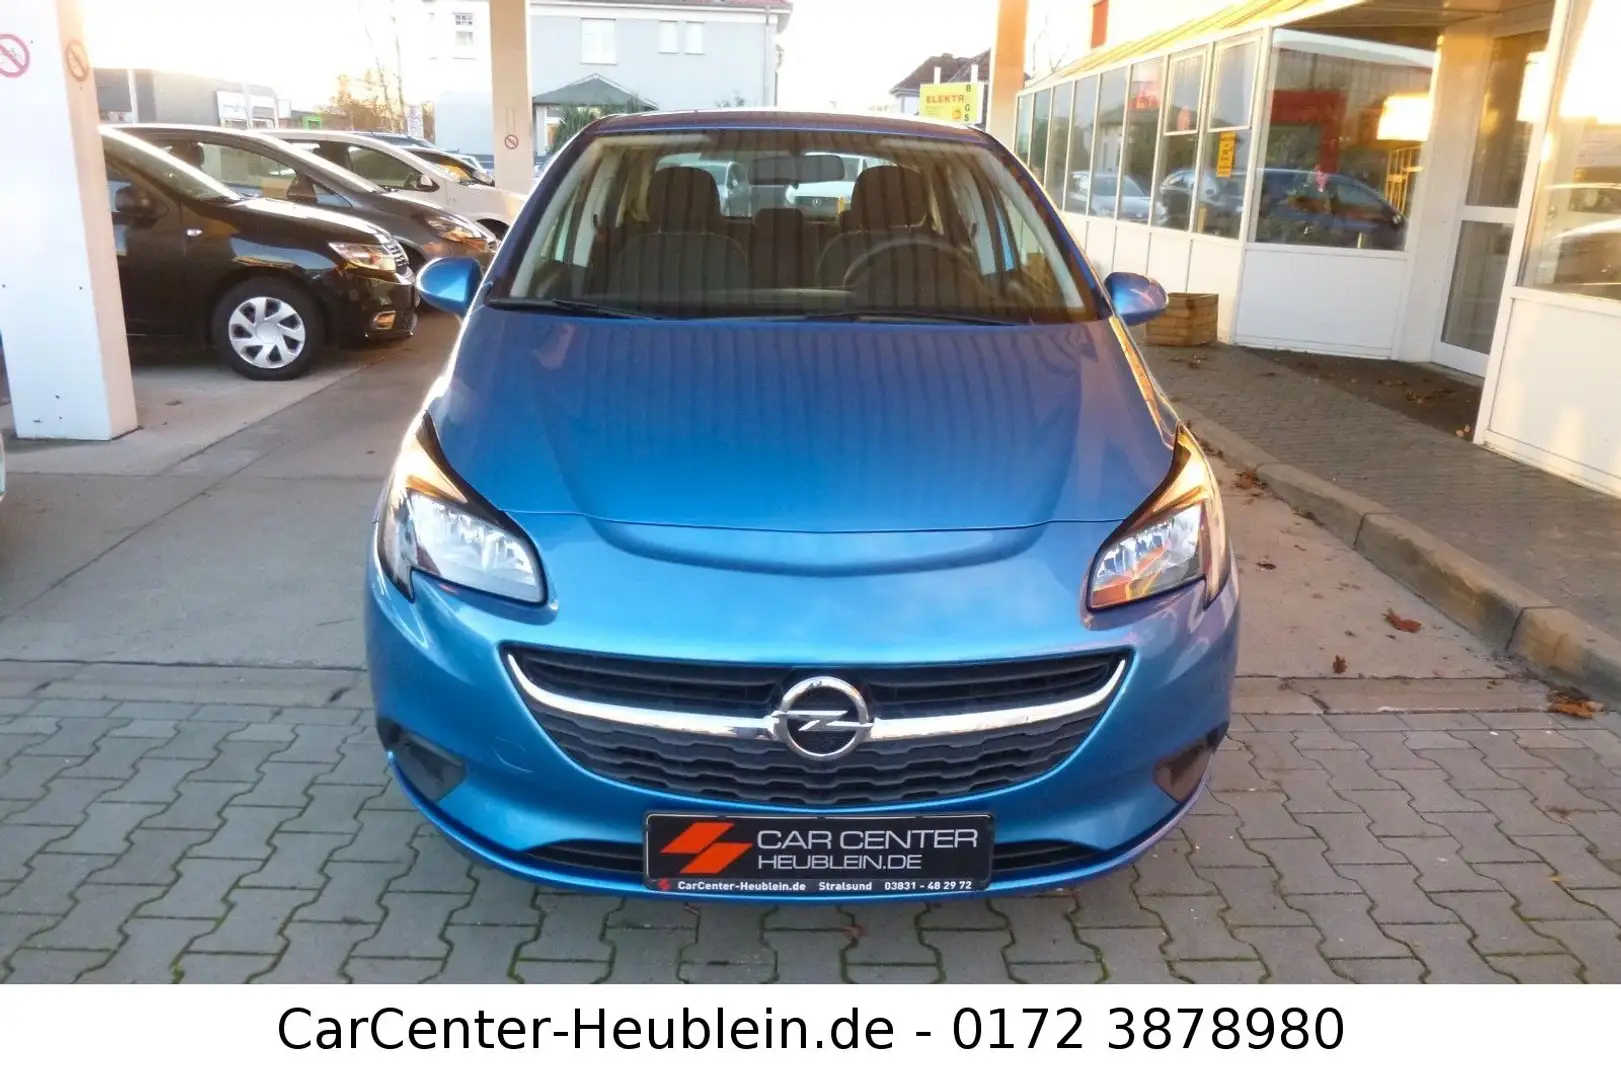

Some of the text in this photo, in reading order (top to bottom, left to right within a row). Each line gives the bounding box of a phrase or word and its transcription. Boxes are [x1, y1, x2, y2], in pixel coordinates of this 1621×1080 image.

[757, 829, 978, 849] CAR CENTER
[758, 854, 922, 869] HEUBLEIN.DE
[677, 880, 806, 891] CarCenter-Heublein.de
[818, 881, 872, 891] Stralsund
[884, 881, 916, 890] 03831
[927, 881, 941, 890] 48
[943, 881, 957, 890] 29
[959, 880, 972, 889] 72
